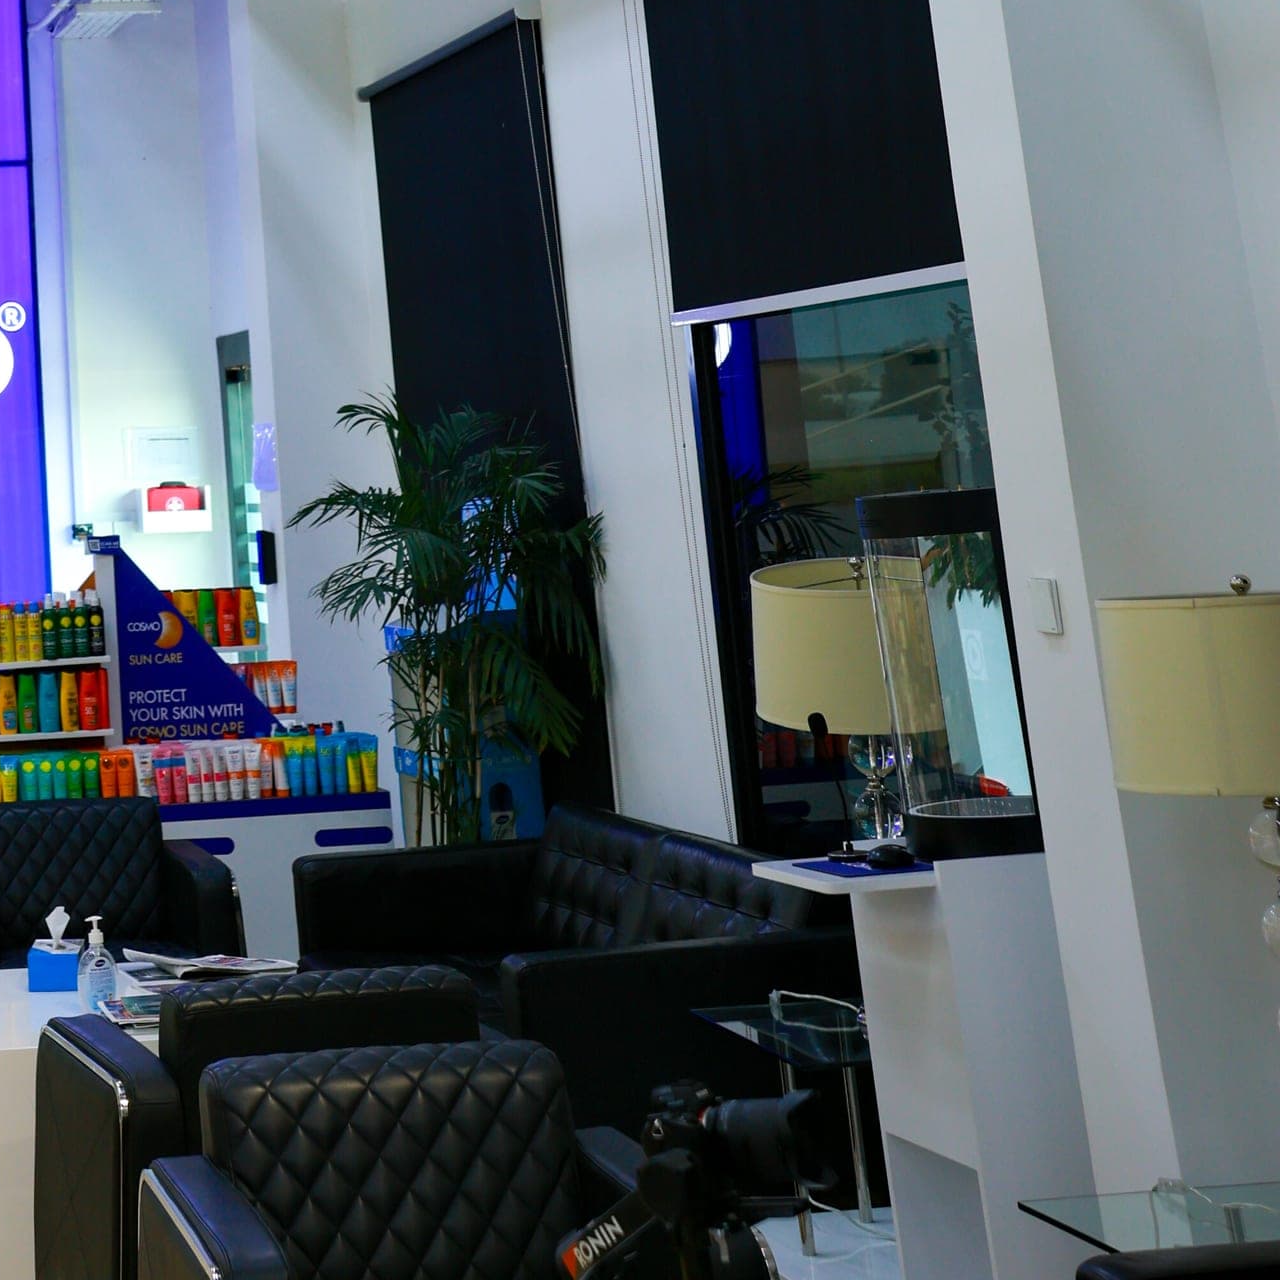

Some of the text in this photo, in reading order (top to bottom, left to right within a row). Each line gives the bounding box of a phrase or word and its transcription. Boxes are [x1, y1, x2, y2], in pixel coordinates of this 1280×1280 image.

[127, 620, 161, 633] COSMO
[128, 652, 183, 666] SUN CARE
[128, 688, 187, 704] PROTECT
[129, 703, 244, 722] YOUR SKIN WITH
[129, 720, 245, 739] COSMO SUN CARE
[573, 1215, 624, 1269] RONIN
